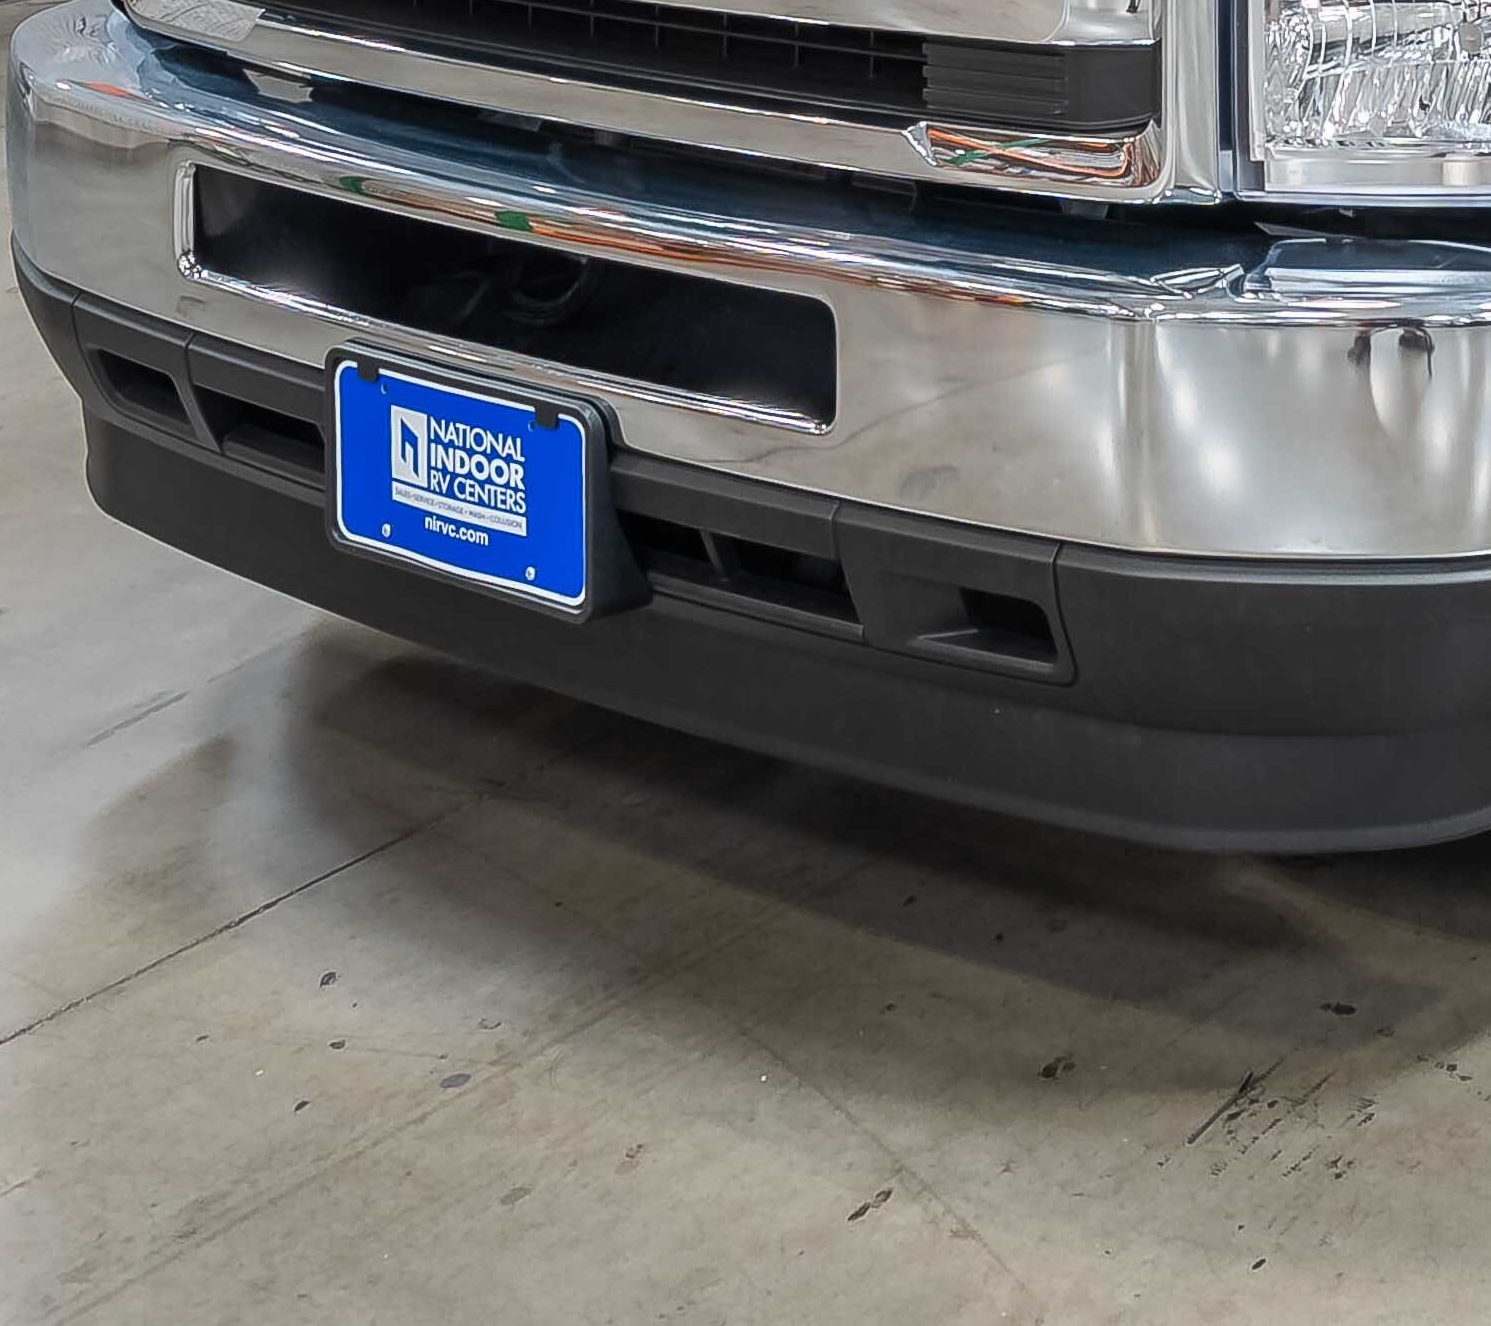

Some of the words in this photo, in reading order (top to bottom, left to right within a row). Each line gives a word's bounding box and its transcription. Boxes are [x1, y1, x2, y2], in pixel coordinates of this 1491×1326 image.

[430, 416, 525, 463] NATIONAL
[430, 443, 525, 490] INDOOR
[430, 469, 450, 494] RV
[453, 477, 526, 513] CENTERS
[424, 516, 489, 546] nirvc.com
